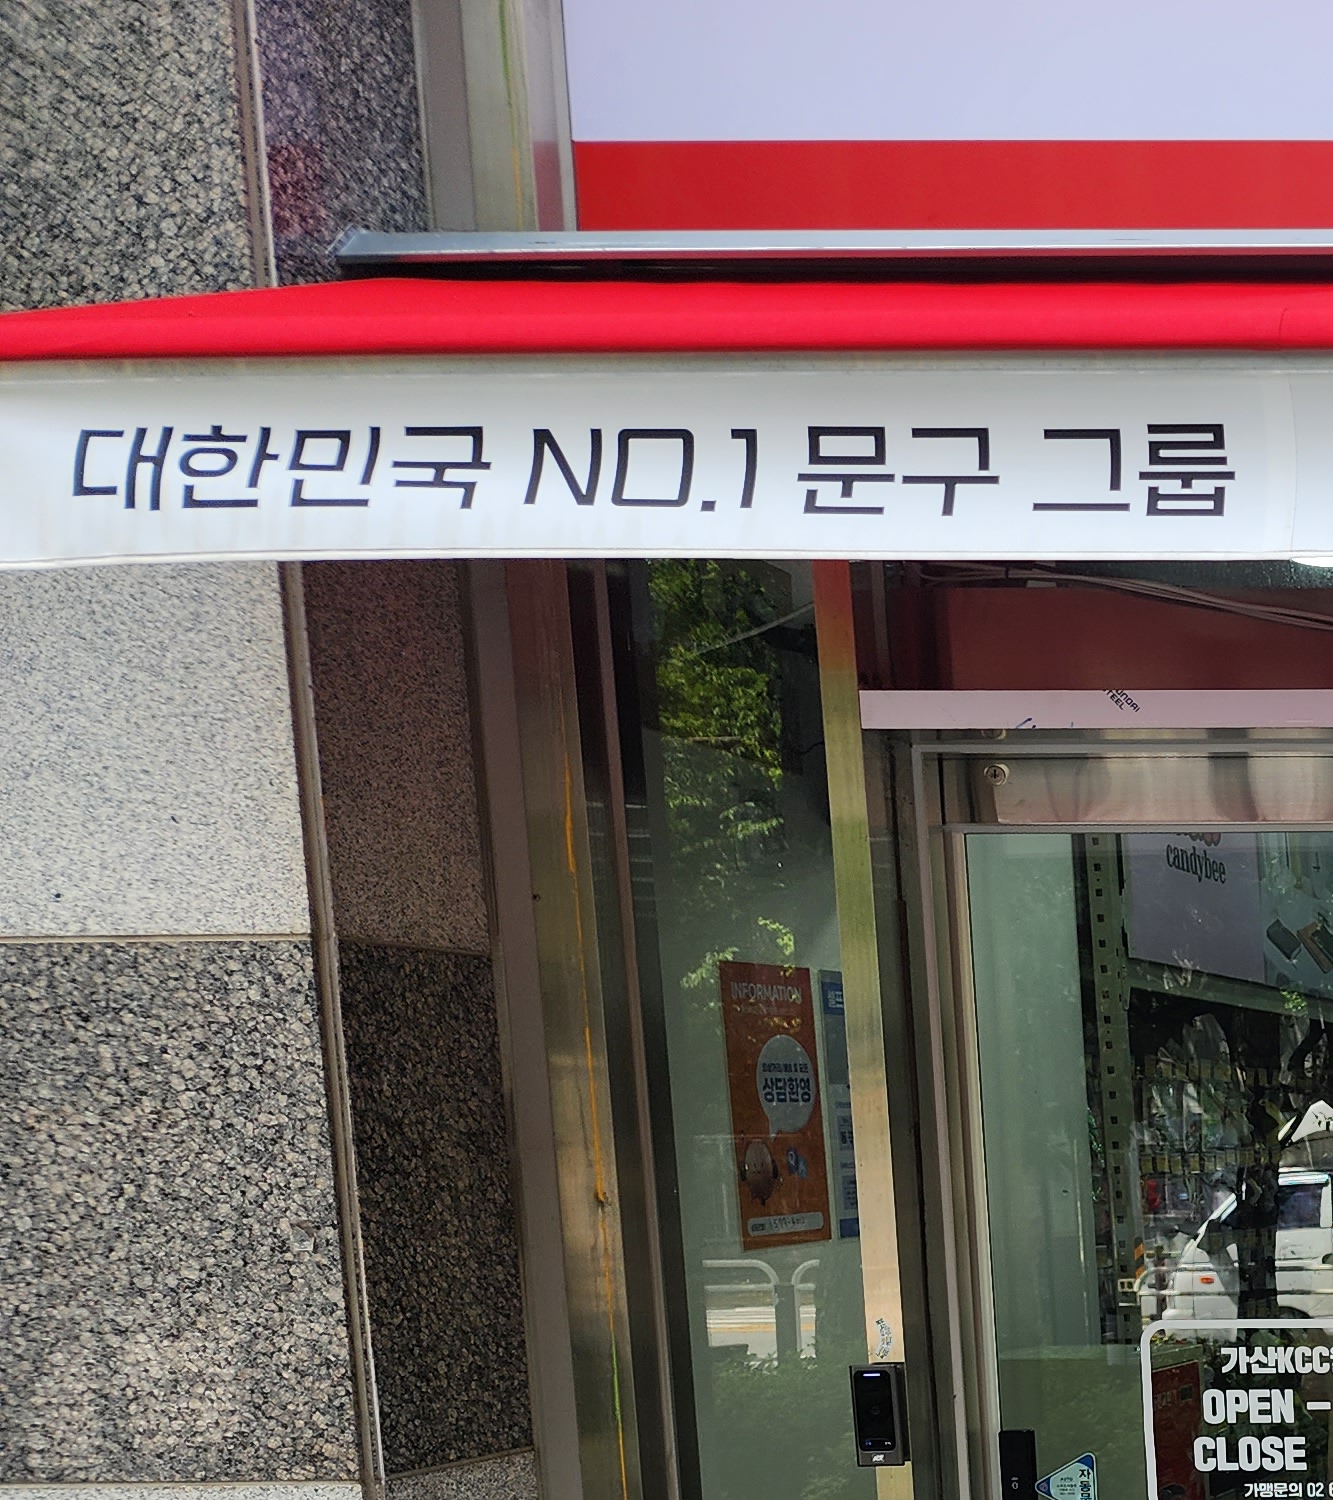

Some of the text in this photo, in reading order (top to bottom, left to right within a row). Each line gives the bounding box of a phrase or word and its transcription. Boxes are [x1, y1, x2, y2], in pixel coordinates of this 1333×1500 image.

[71, 423, 1236, 518] 대한민국 NO.1 문구 그룹
[1166, 843, 1226, 885] candybee
[731, 981, 802, 1002] INFORMATION
[763, 1077, 811, 1102] 상담환영
[1203, 1389, 1294, 1425] OPEN
[1193, 1436, 1307, 1472] CLOSE
[1244, 1482, 1302, 1499] 가맹문의
[1307, 1482, 1325, 1497] 02
